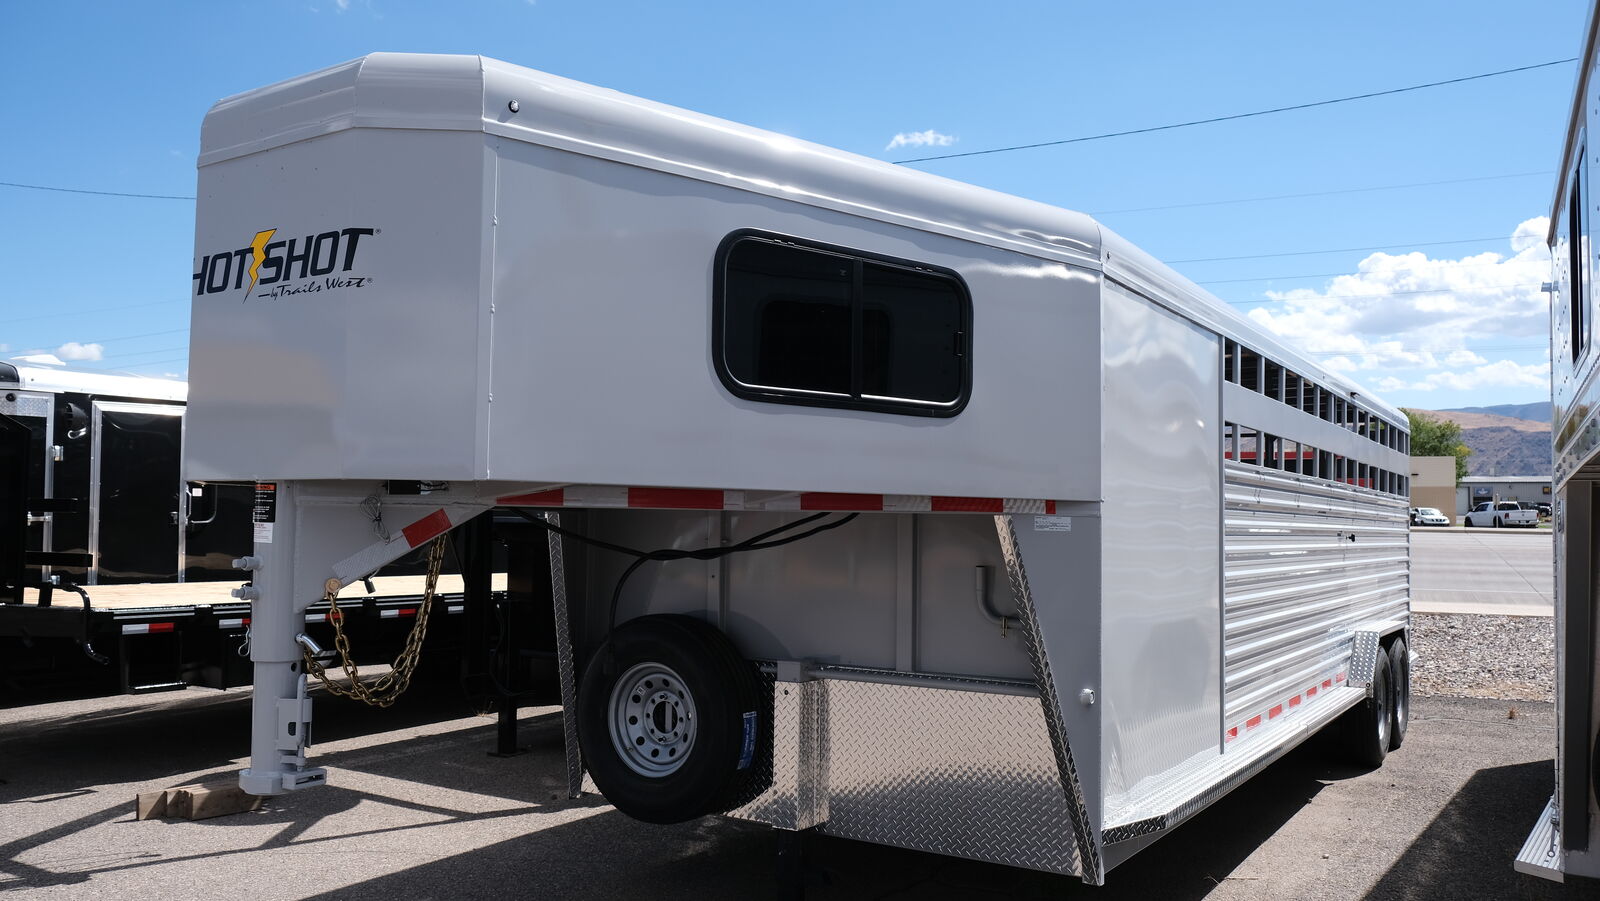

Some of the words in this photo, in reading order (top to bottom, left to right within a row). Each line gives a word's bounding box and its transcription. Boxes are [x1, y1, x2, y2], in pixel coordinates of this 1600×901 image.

[259, 227, 374, 286] SHOT
[270, 288, 278, 300] by
[277, 281, 322, 297] Trails
[325, 276, 366, 289] West
